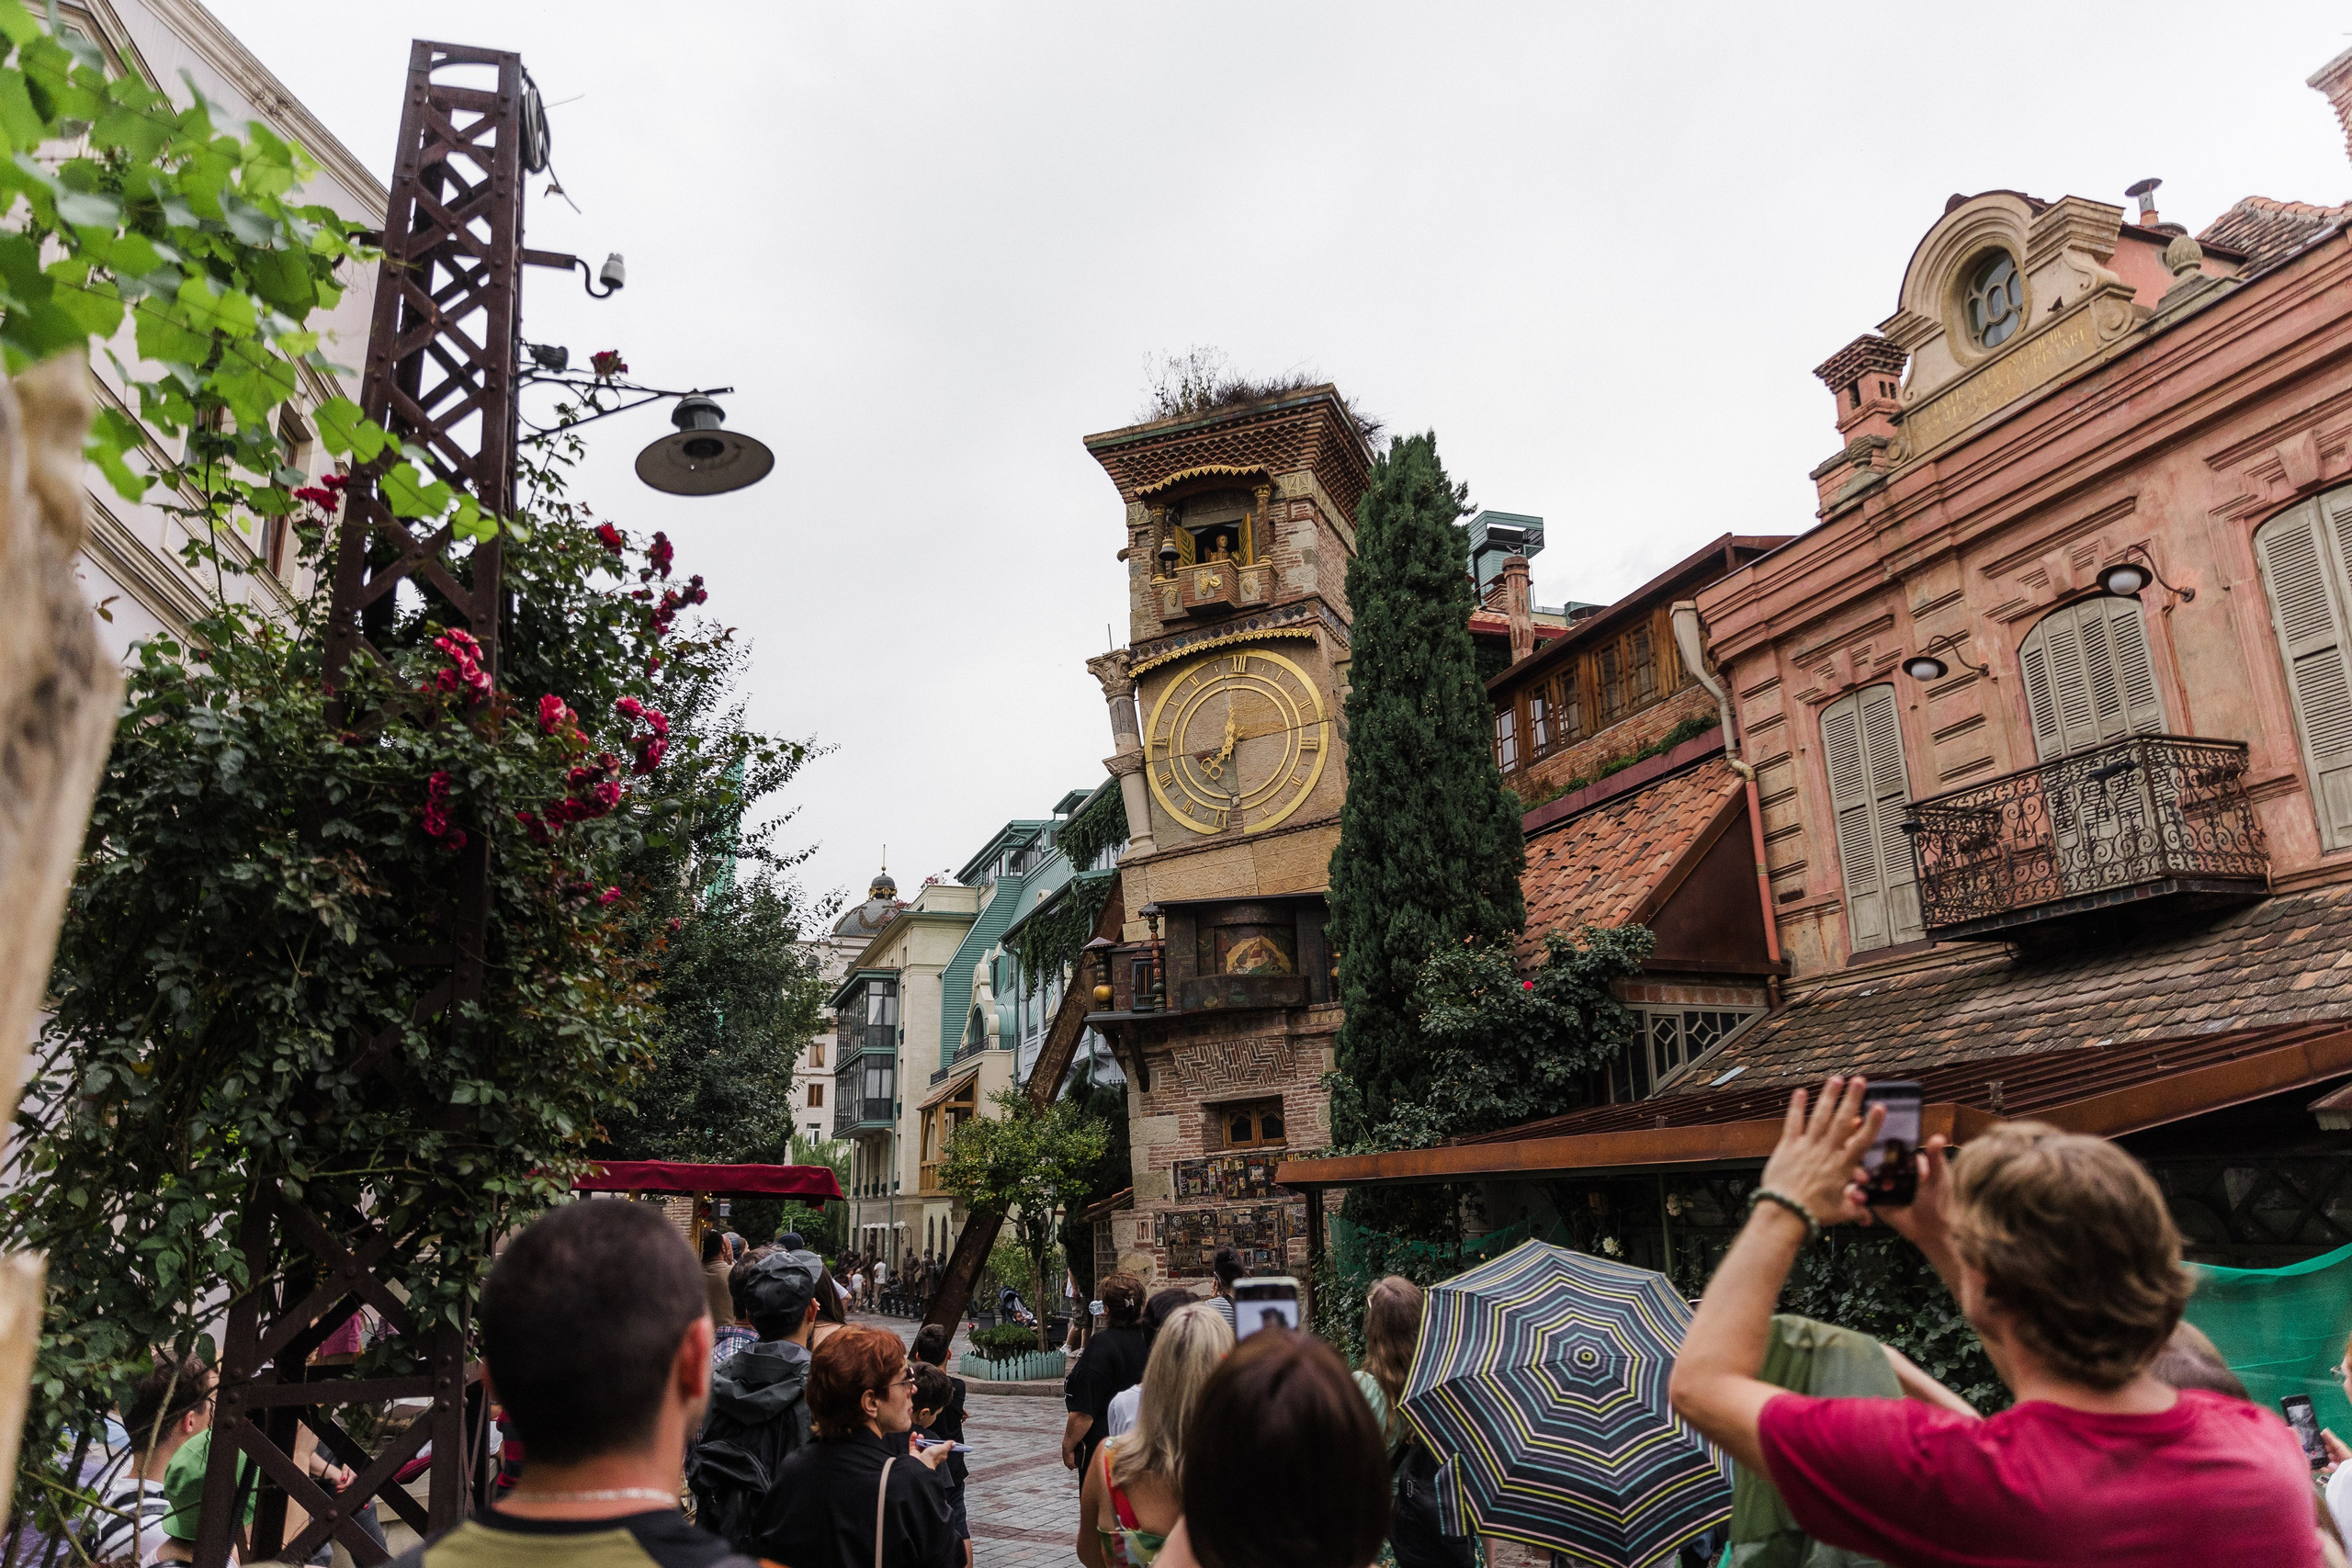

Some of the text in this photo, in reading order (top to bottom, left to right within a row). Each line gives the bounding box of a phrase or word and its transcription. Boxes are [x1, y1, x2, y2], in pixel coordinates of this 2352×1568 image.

[1230, 655, 1247, 672] XII
[1298, 699, 1311, 710] II
[1300, 736, 1319, 750] III
[1159, 771, 1173, 789] VIII
[1182, 799, 1195, 816] VII
